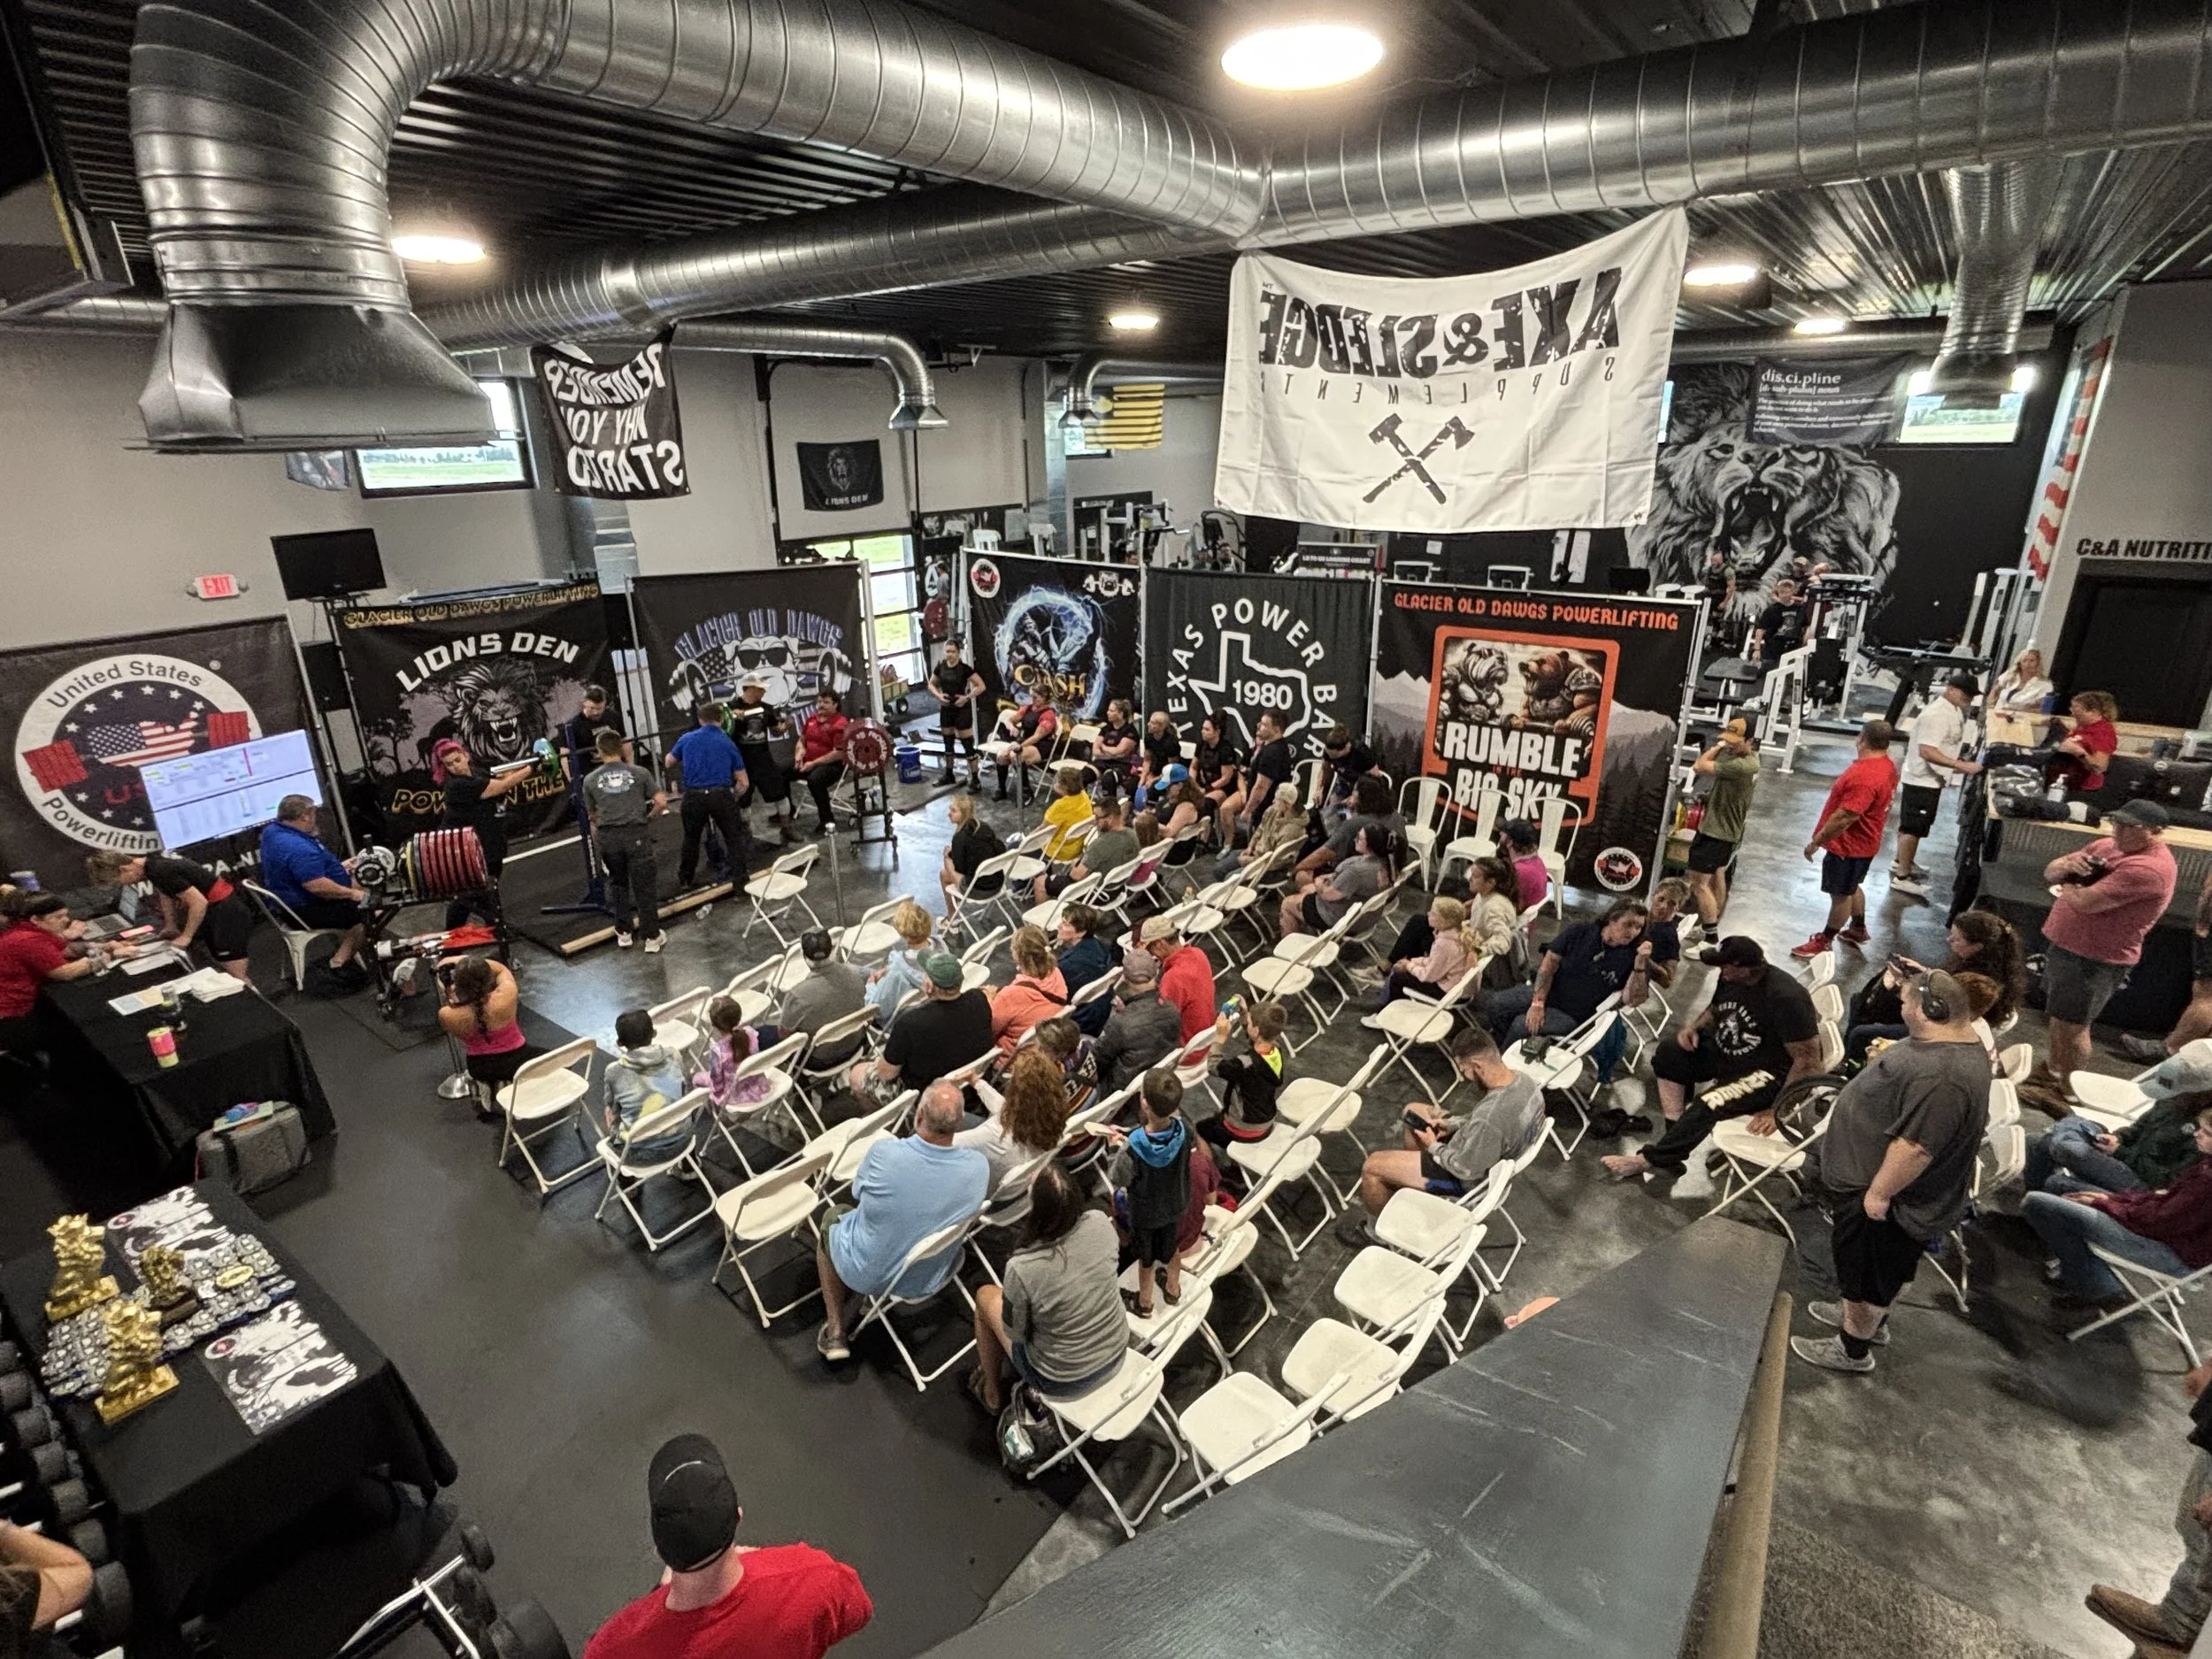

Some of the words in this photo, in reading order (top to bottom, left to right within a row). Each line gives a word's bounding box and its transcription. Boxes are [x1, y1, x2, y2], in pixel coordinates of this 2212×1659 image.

[1761, 368, 1841, 388] dis.ci.pline
[2076, 538, 2120, 557] C&A
[2124, 539, 2212, 560] NUTRITI
[202, 575, 233, 596] EXIT
[674, 611, 743, 661] GLACIER
[749, 608, 779, 638] OLD
[787, 608, 843, 649] DAWGS
[1394, 591, 1454, 613] GLACIER
[1457, 595, 1486, 615] OLD
[1491, 599, 1548, 620] DAWGS
[1552, 604, 1678, 631] POWERLIFTING
[47, 663, 123, 709] United
[129, 660, 203, 688] States
[396, 633, 503, 693] LIONS
[511, 632, 580, 664] DEN
[1166, 623, 1204, 740] TEXAS
[1211, 597, 1325, 668] POWER
[1302, 684, 1338, 758] BAR
[1232, 679, 1294, 710] 1980
[1442, 720, 1582, 779] RUMBLE
[42, 796, 160, 850] Powerliftin
